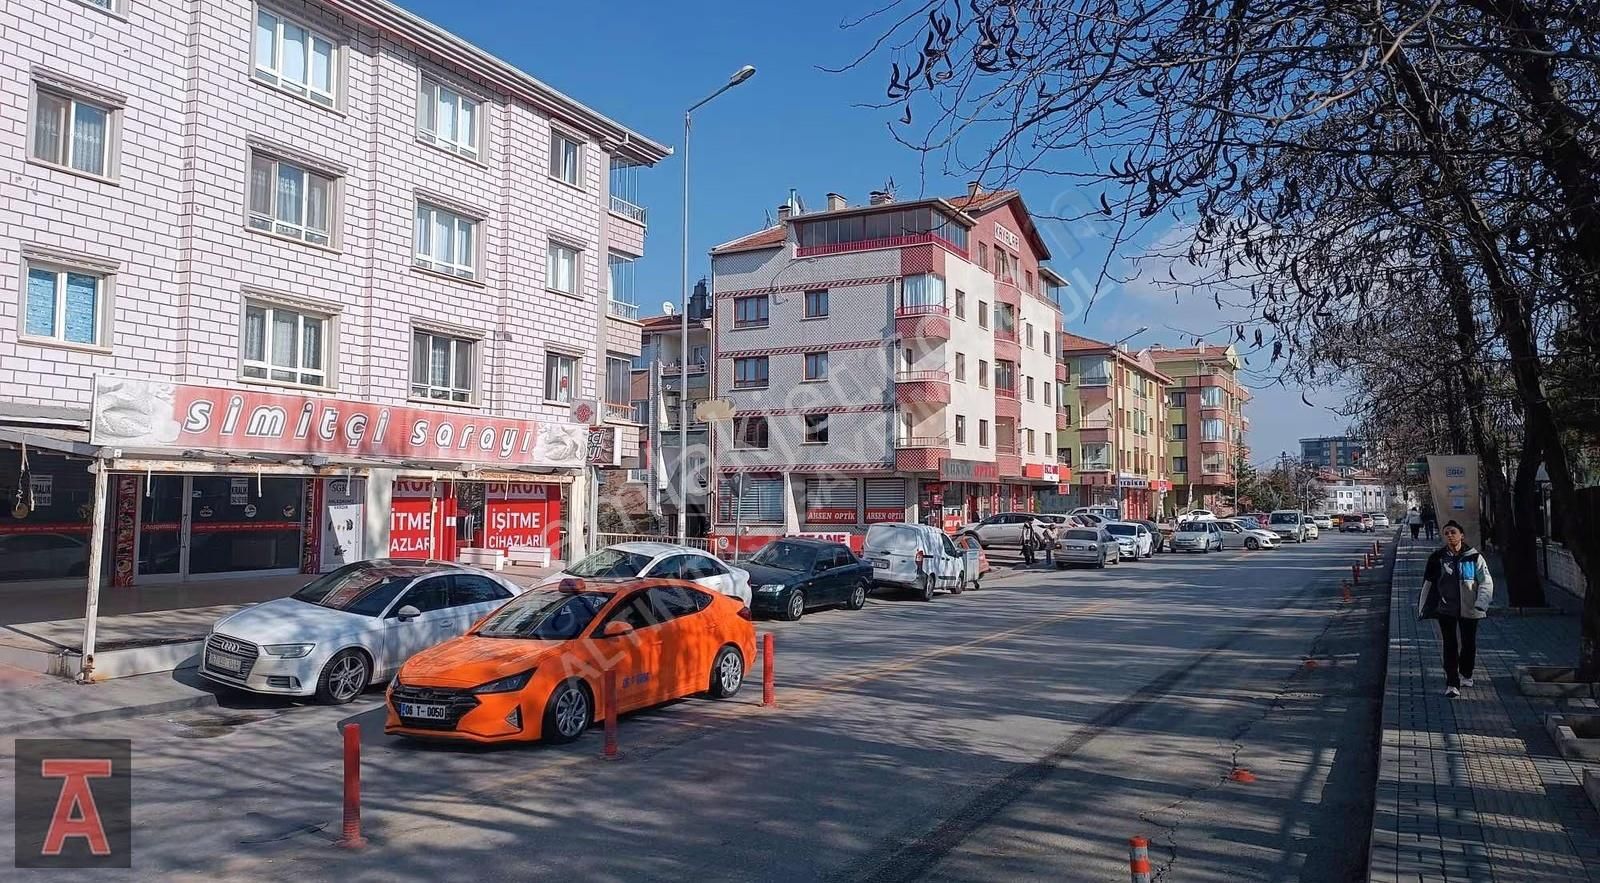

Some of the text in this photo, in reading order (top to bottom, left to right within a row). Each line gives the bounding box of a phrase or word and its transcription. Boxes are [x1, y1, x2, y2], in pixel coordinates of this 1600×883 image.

[182, 394, 533, 460] simitçi sarayı
[390, 508, 431, 531] İTME
[491, 508, 541, 532] İŞİTME
[488, 532, 543, 548] CİHAZLARI
